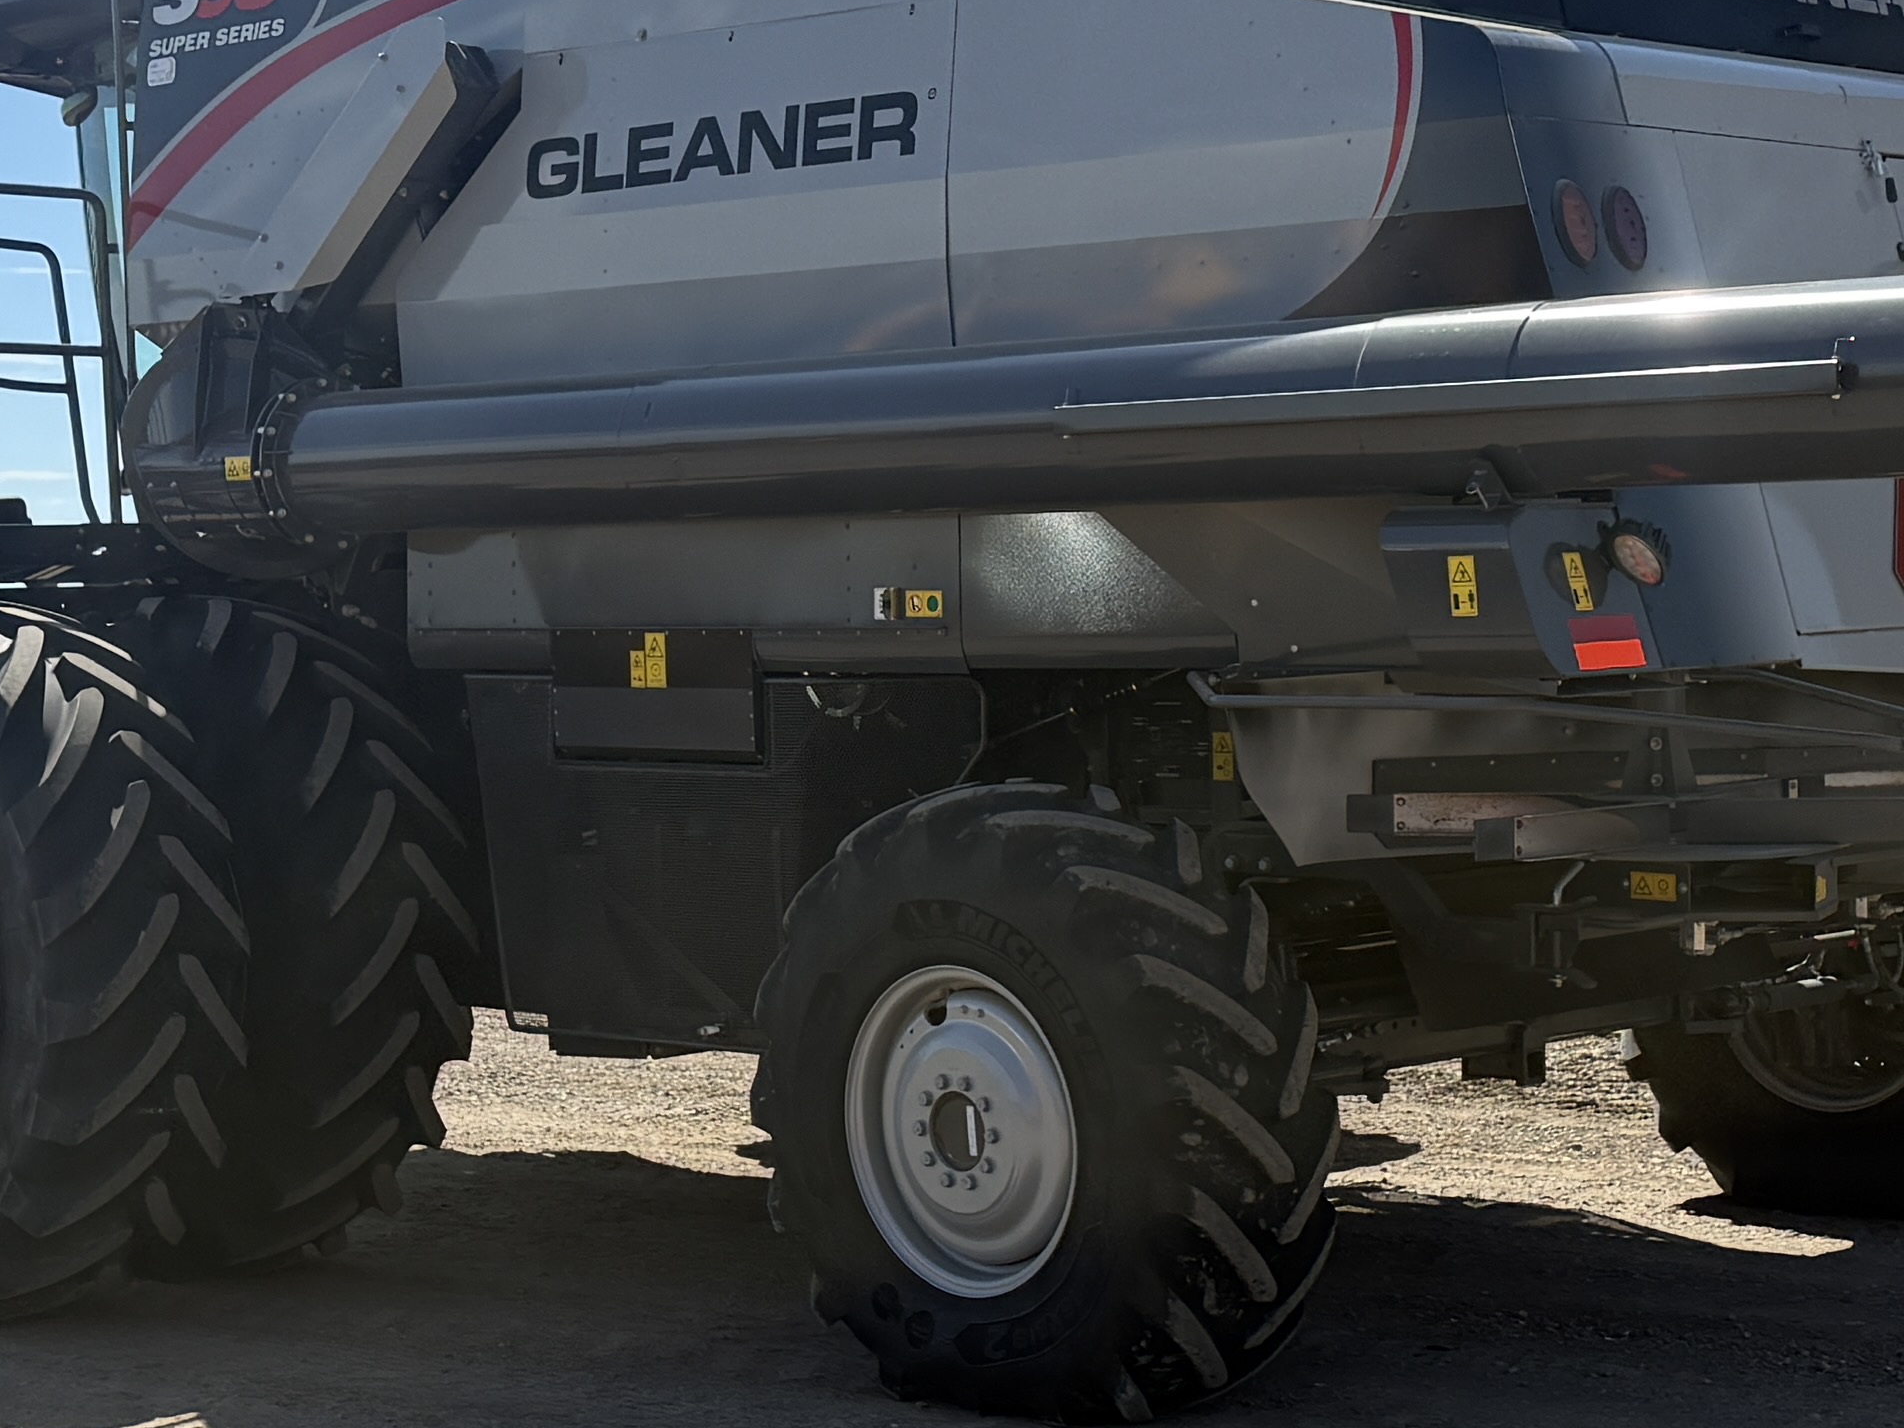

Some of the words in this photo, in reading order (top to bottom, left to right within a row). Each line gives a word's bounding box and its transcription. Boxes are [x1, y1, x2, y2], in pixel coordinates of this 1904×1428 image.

[148, 30, 211, 58] SUPER
[214, 18, 286, 47] SERIES
[525, 91, 920, 200] GLEANER
